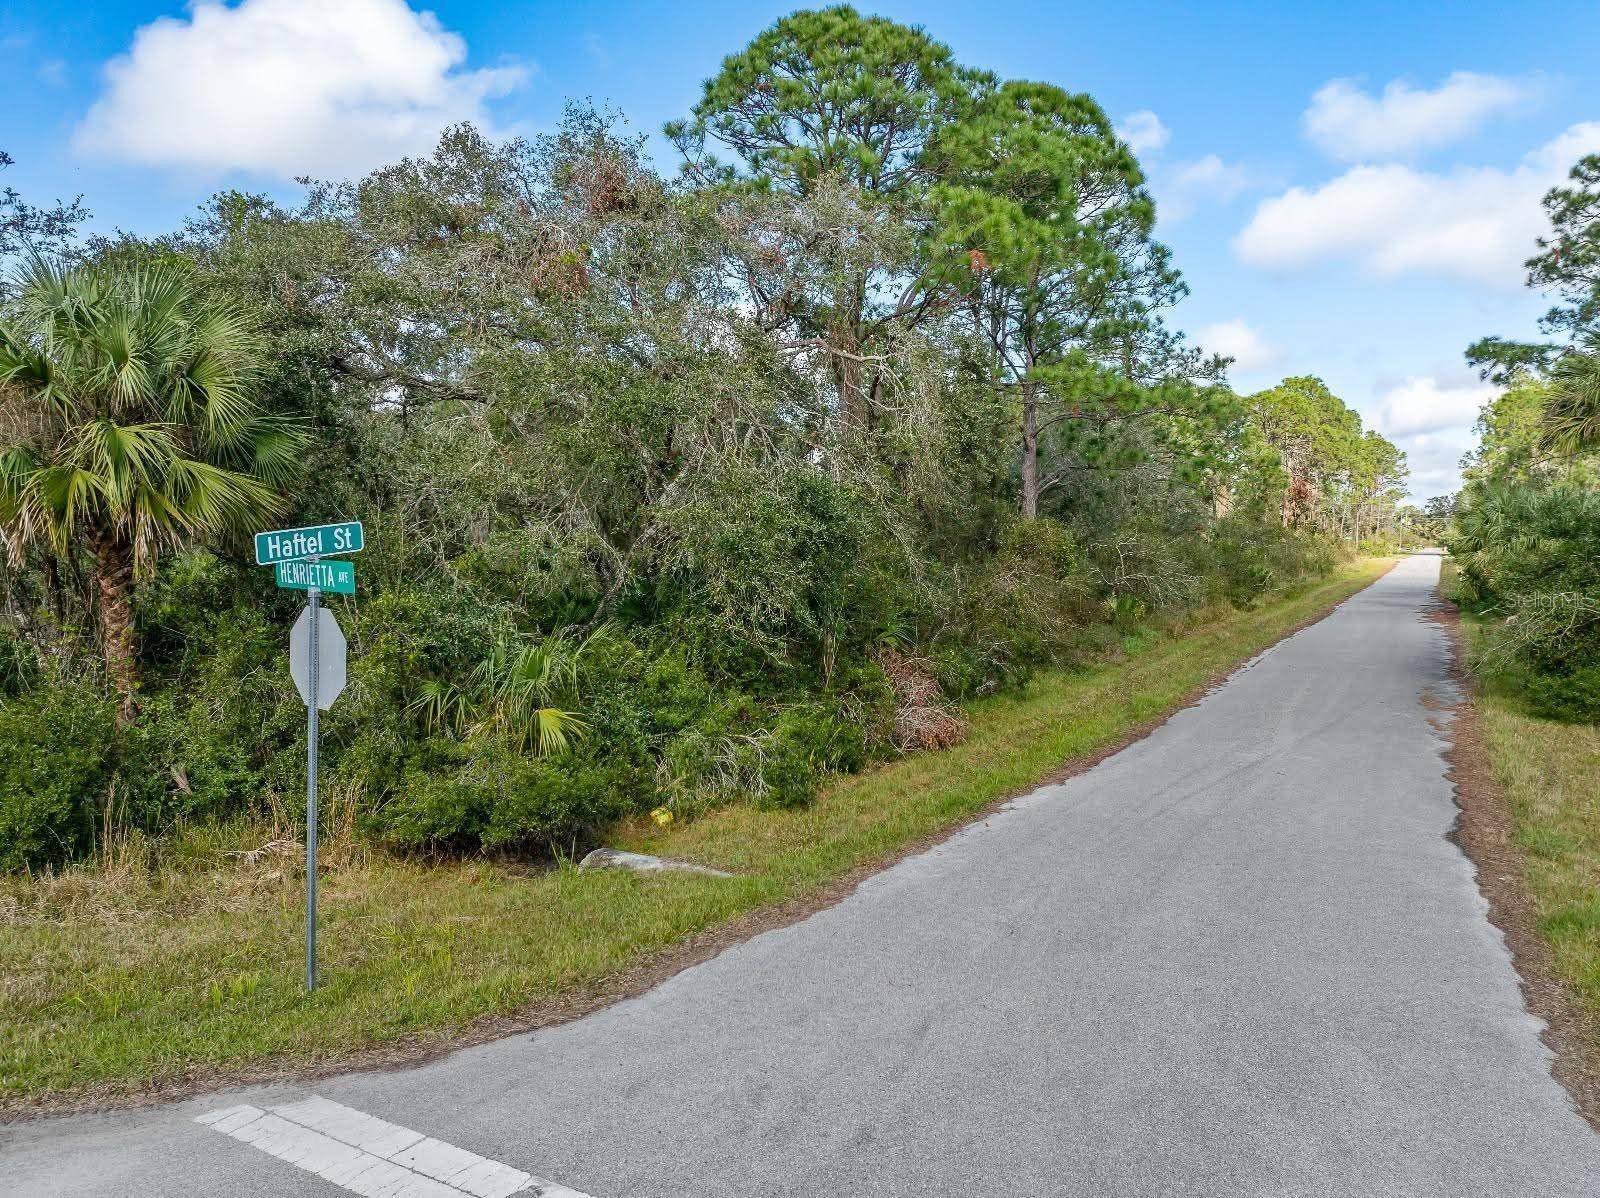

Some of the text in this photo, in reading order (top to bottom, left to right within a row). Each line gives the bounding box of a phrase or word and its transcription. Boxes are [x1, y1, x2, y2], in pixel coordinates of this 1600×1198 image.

[267, 527, 353, 559] Haftel St
[280, 560, 349, 588] HENRIETTA AVE
